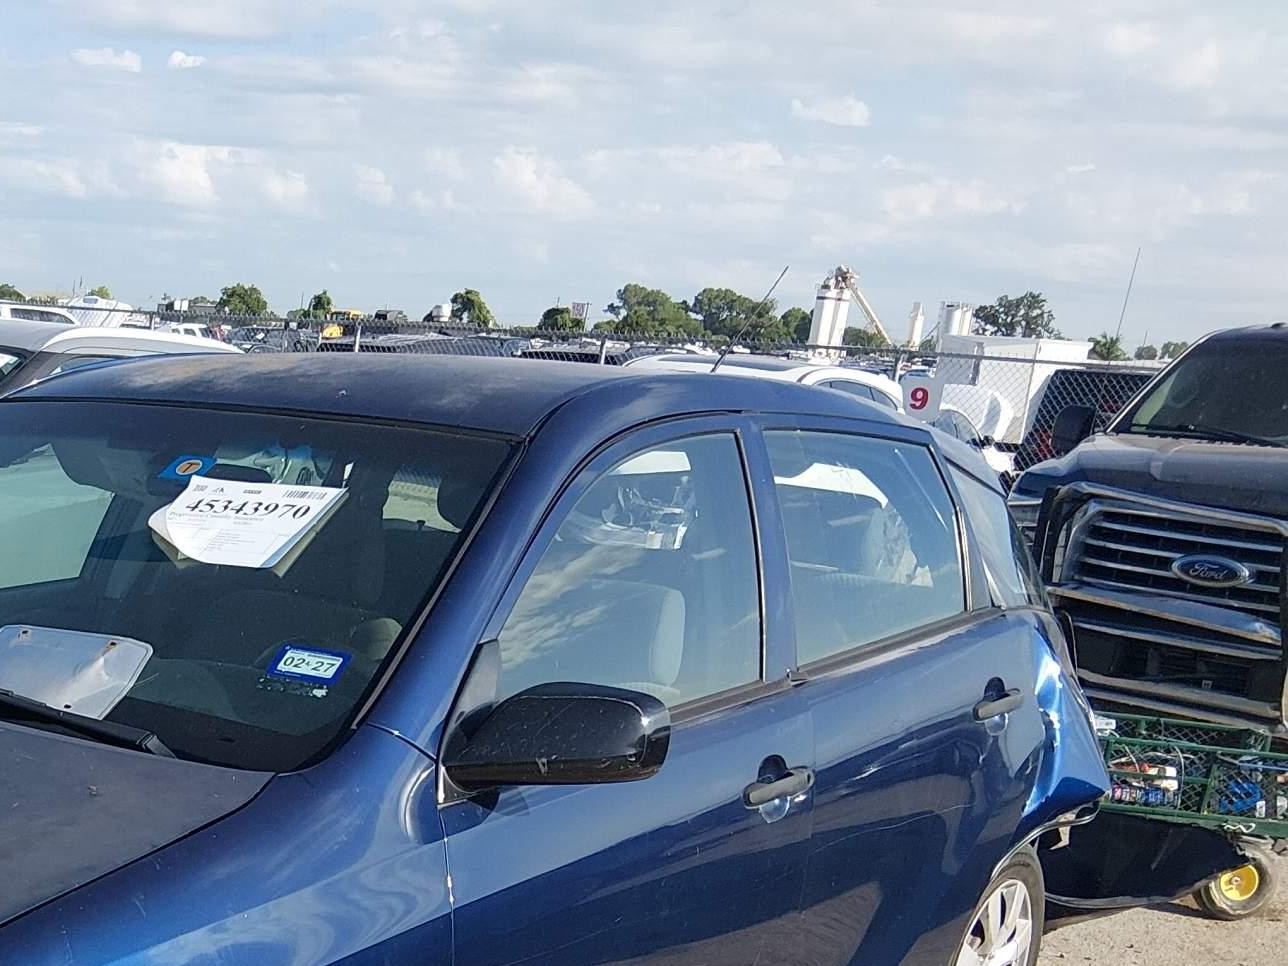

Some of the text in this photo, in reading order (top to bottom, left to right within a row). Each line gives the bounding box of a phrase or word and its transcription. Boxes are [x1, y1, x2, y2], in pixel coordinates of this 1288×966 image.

[909, 387, 929, 410] 9
[185, 498, 311, 520] 45343970
[1189, 562, 1228, 579] Ford
